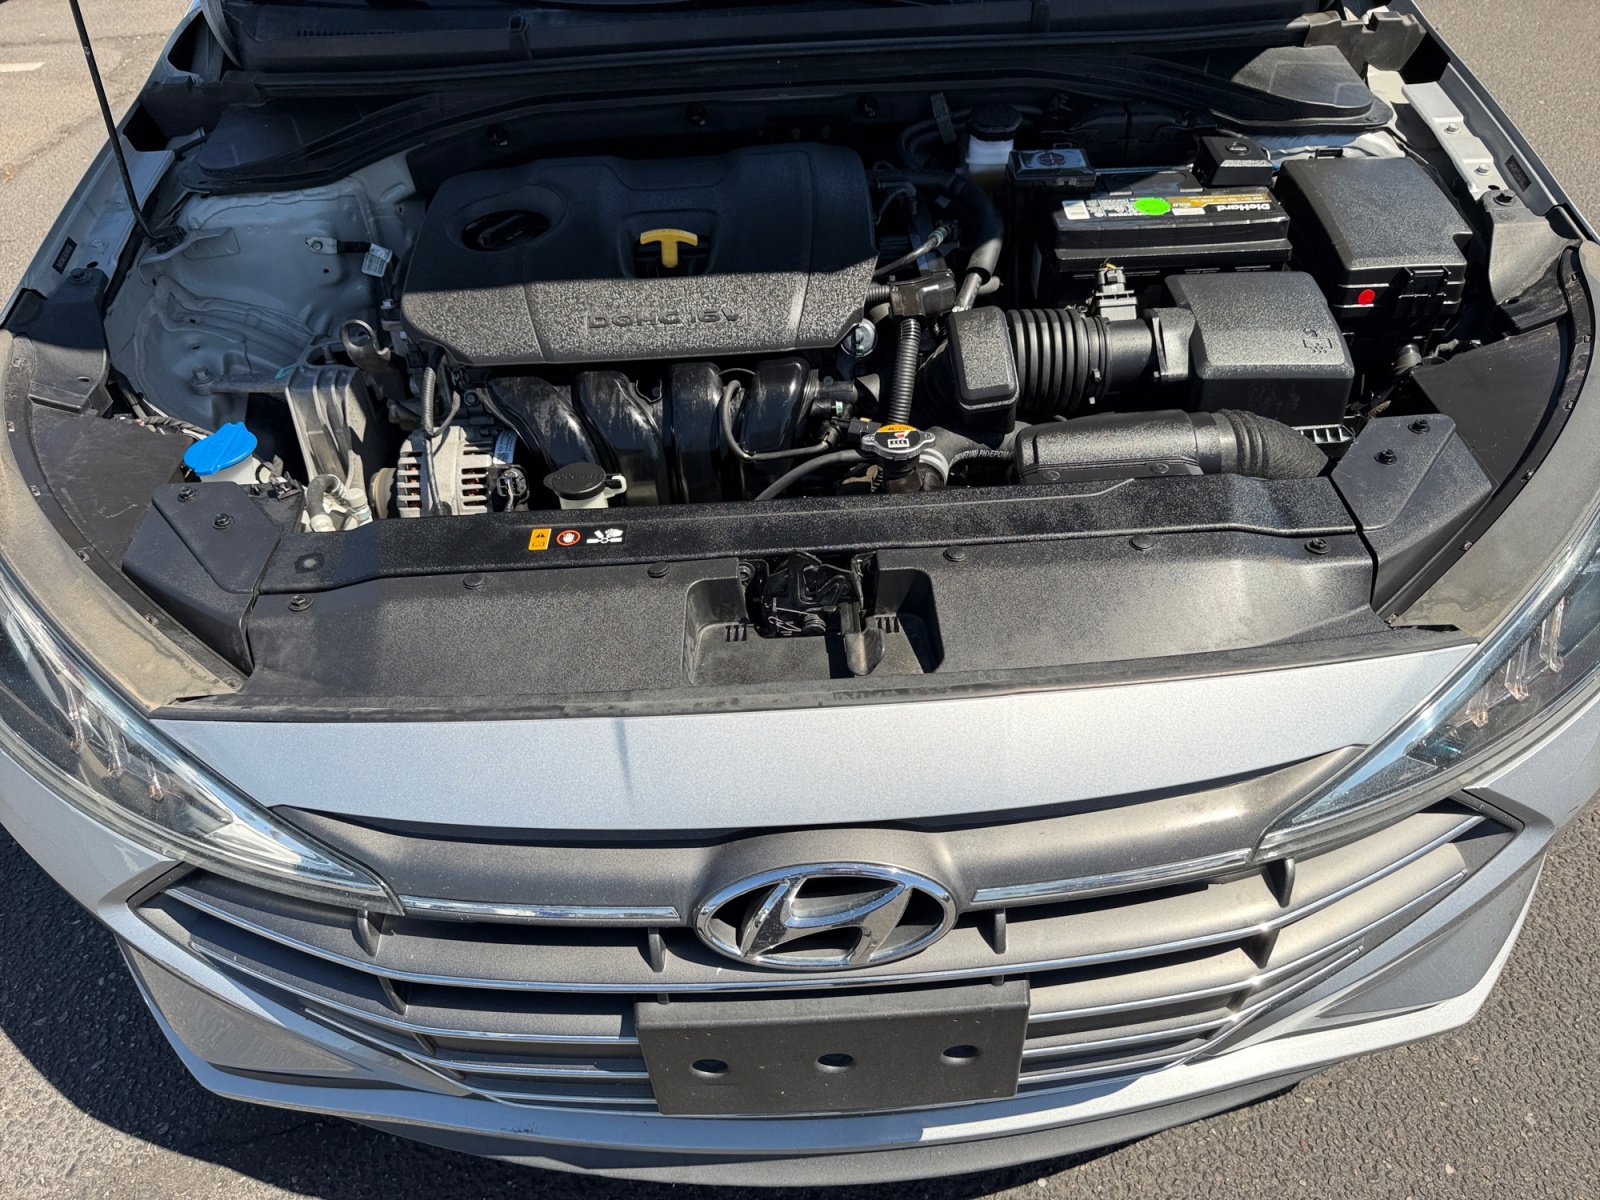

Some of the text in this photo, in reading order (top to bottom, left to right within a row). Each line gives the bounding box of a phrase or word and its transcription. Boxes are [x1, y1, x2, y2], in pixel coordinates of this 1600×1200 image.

[1217, 203, 1271, 211] DieHard
[588, 307, 743, 328] DOHC 16V
